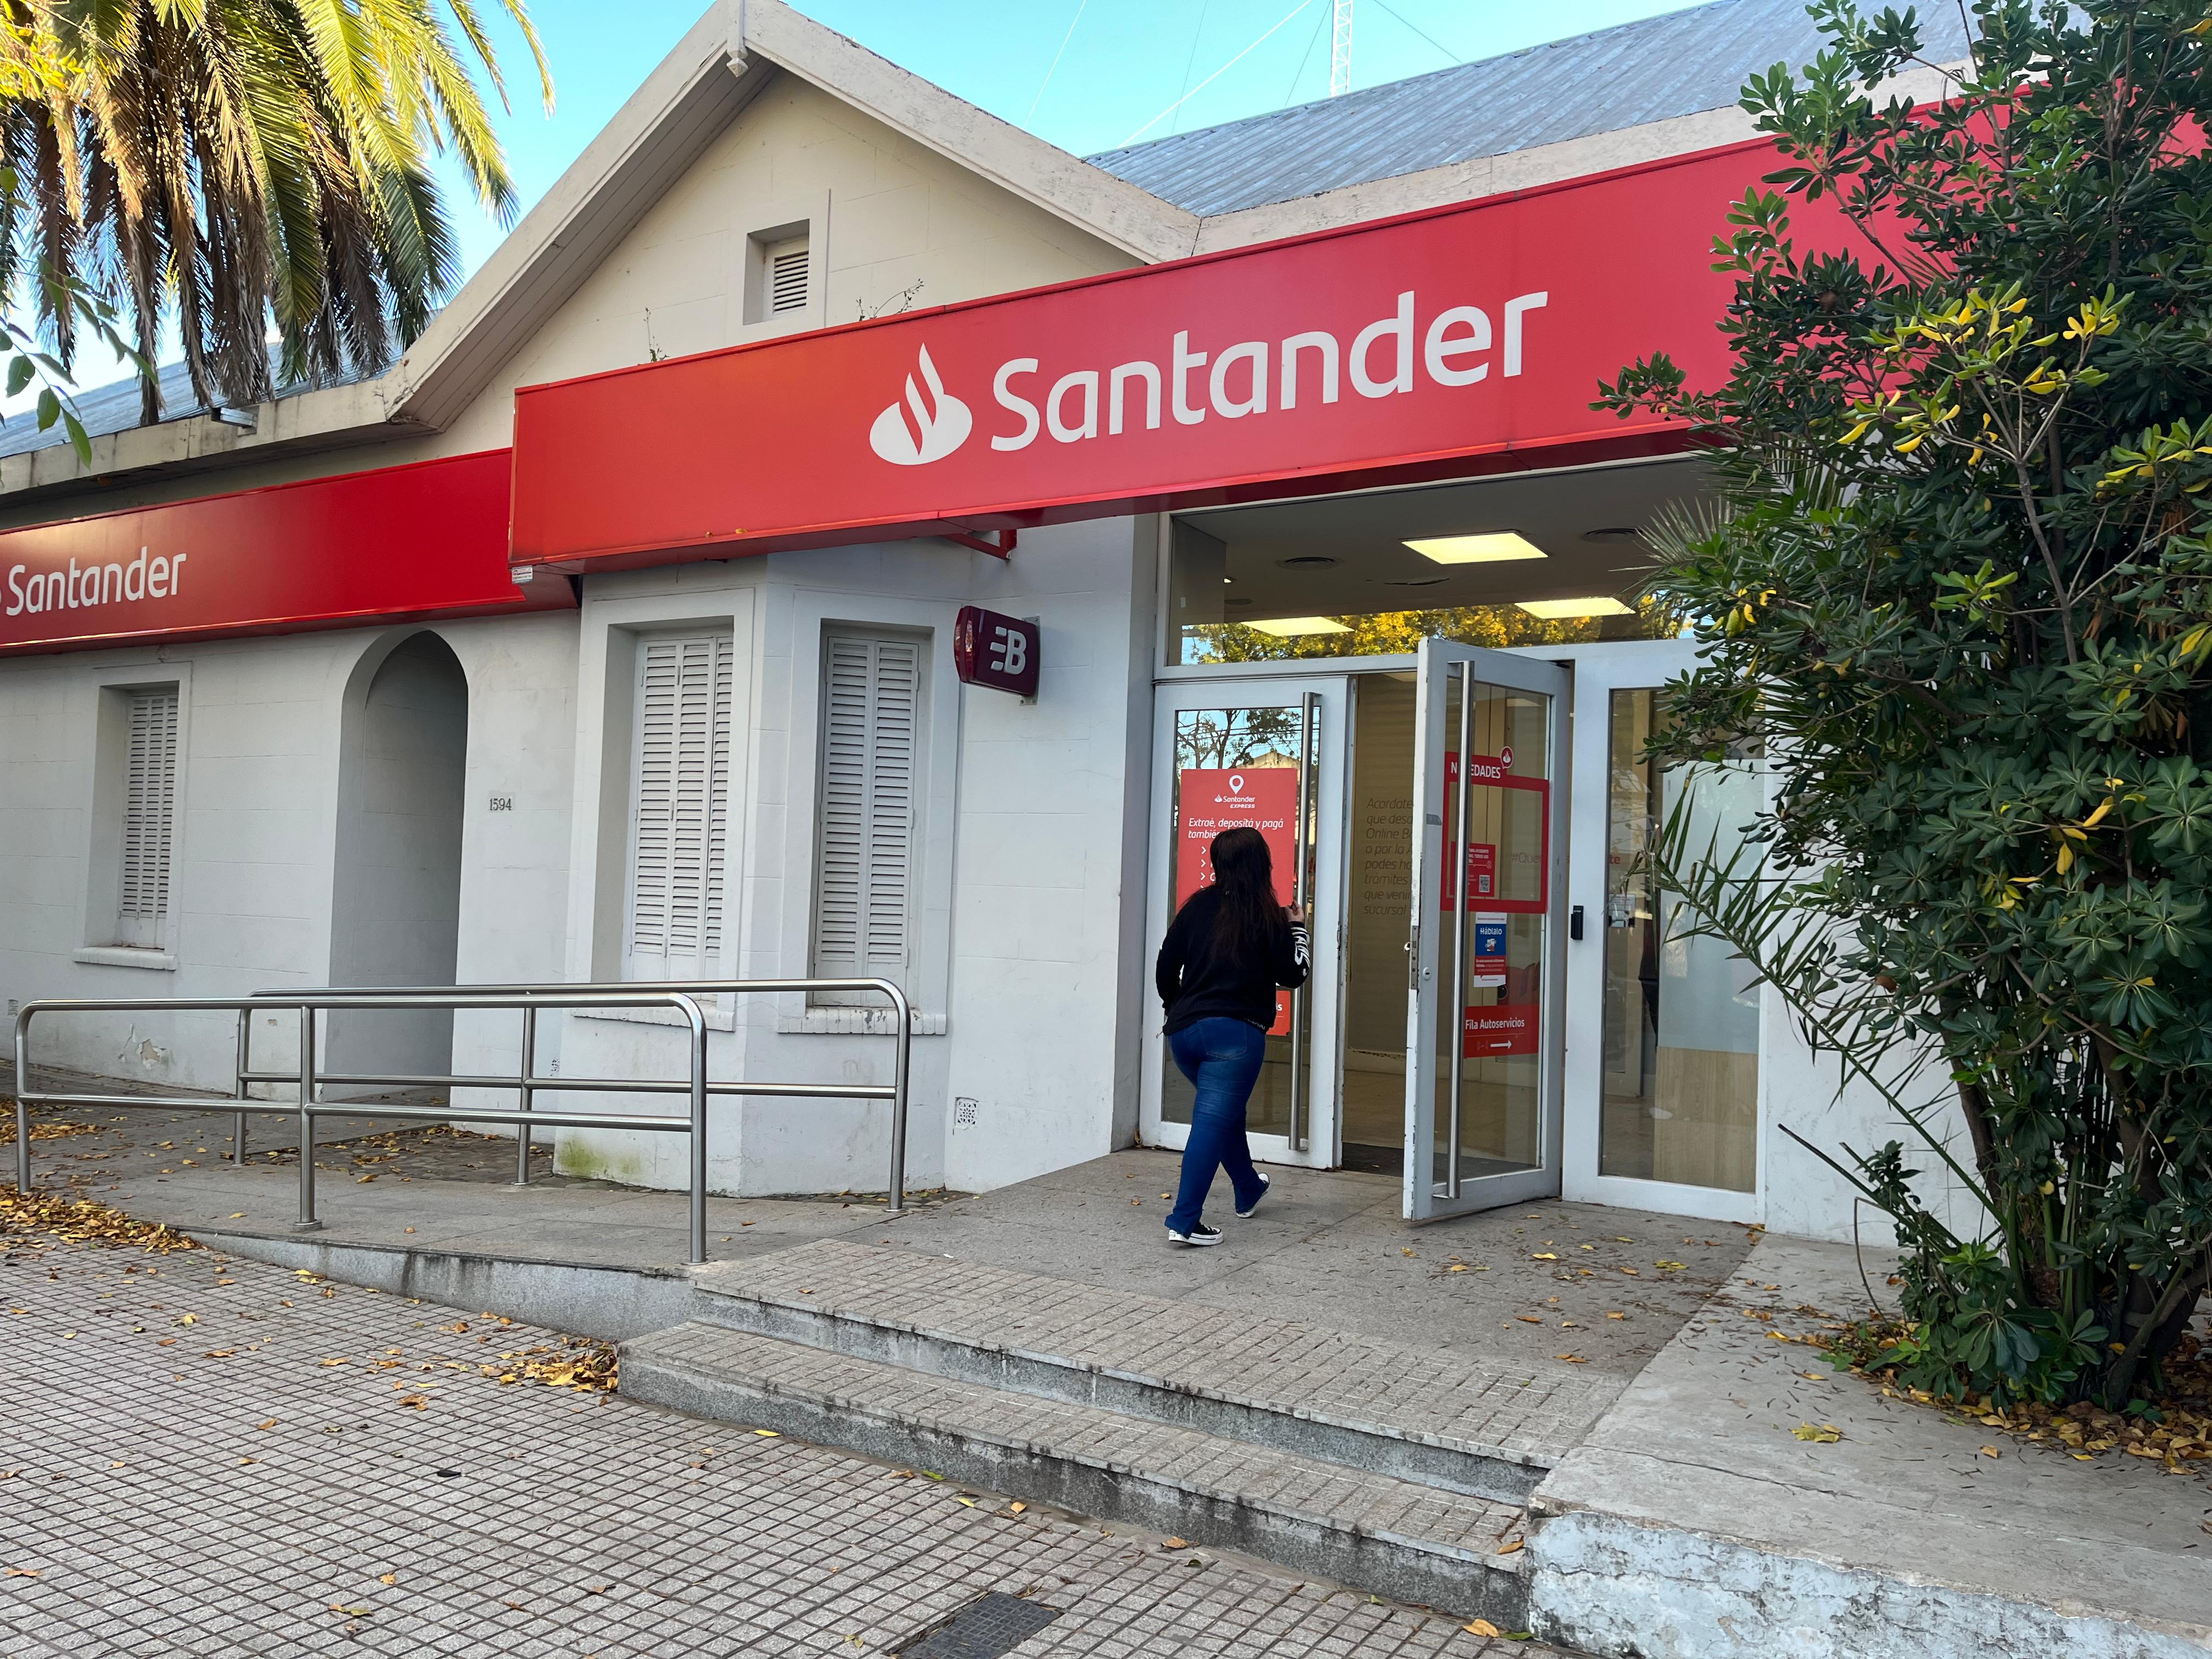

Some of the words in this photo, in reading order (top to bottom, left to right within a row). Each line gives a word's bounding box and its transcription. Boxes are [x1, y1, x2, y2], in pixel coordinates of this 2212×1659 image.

[991, 291, 1548, 452] Santander
[6, 546, 187, 616] Santander
[1451, 761, 1501, 779] NEDADES
[490, 798, 512, 811] 1594
[1366, 798, 1413, 809] Acordate
[1188, 818, 1216, 828] Extraé,
[1218, 818, 1254, 829] depositá
[1255, 820, 1260, 830] y
[1261, 818, 1284, 830] pagá
[1366, 815, 1386, 826] que
[1366, 827, 1399, 839] Online
[1365, 845, 1372, 854] o
[1374, 845, 1392, 856] por
[1395, 844, 1404, 854] la
[1365, 858, 1396, 871] podés
[1364, 873, 1408, 885] trámites
[1364, 890, 1384, 901] que
[1363, 906, 1407, 916] sucursal
[1480, 927, 1503, 935] Háblalo
[1465, 1019, 1478, 1030] Fila
[1480, 1017, 1525, 1029] Autoservicios
